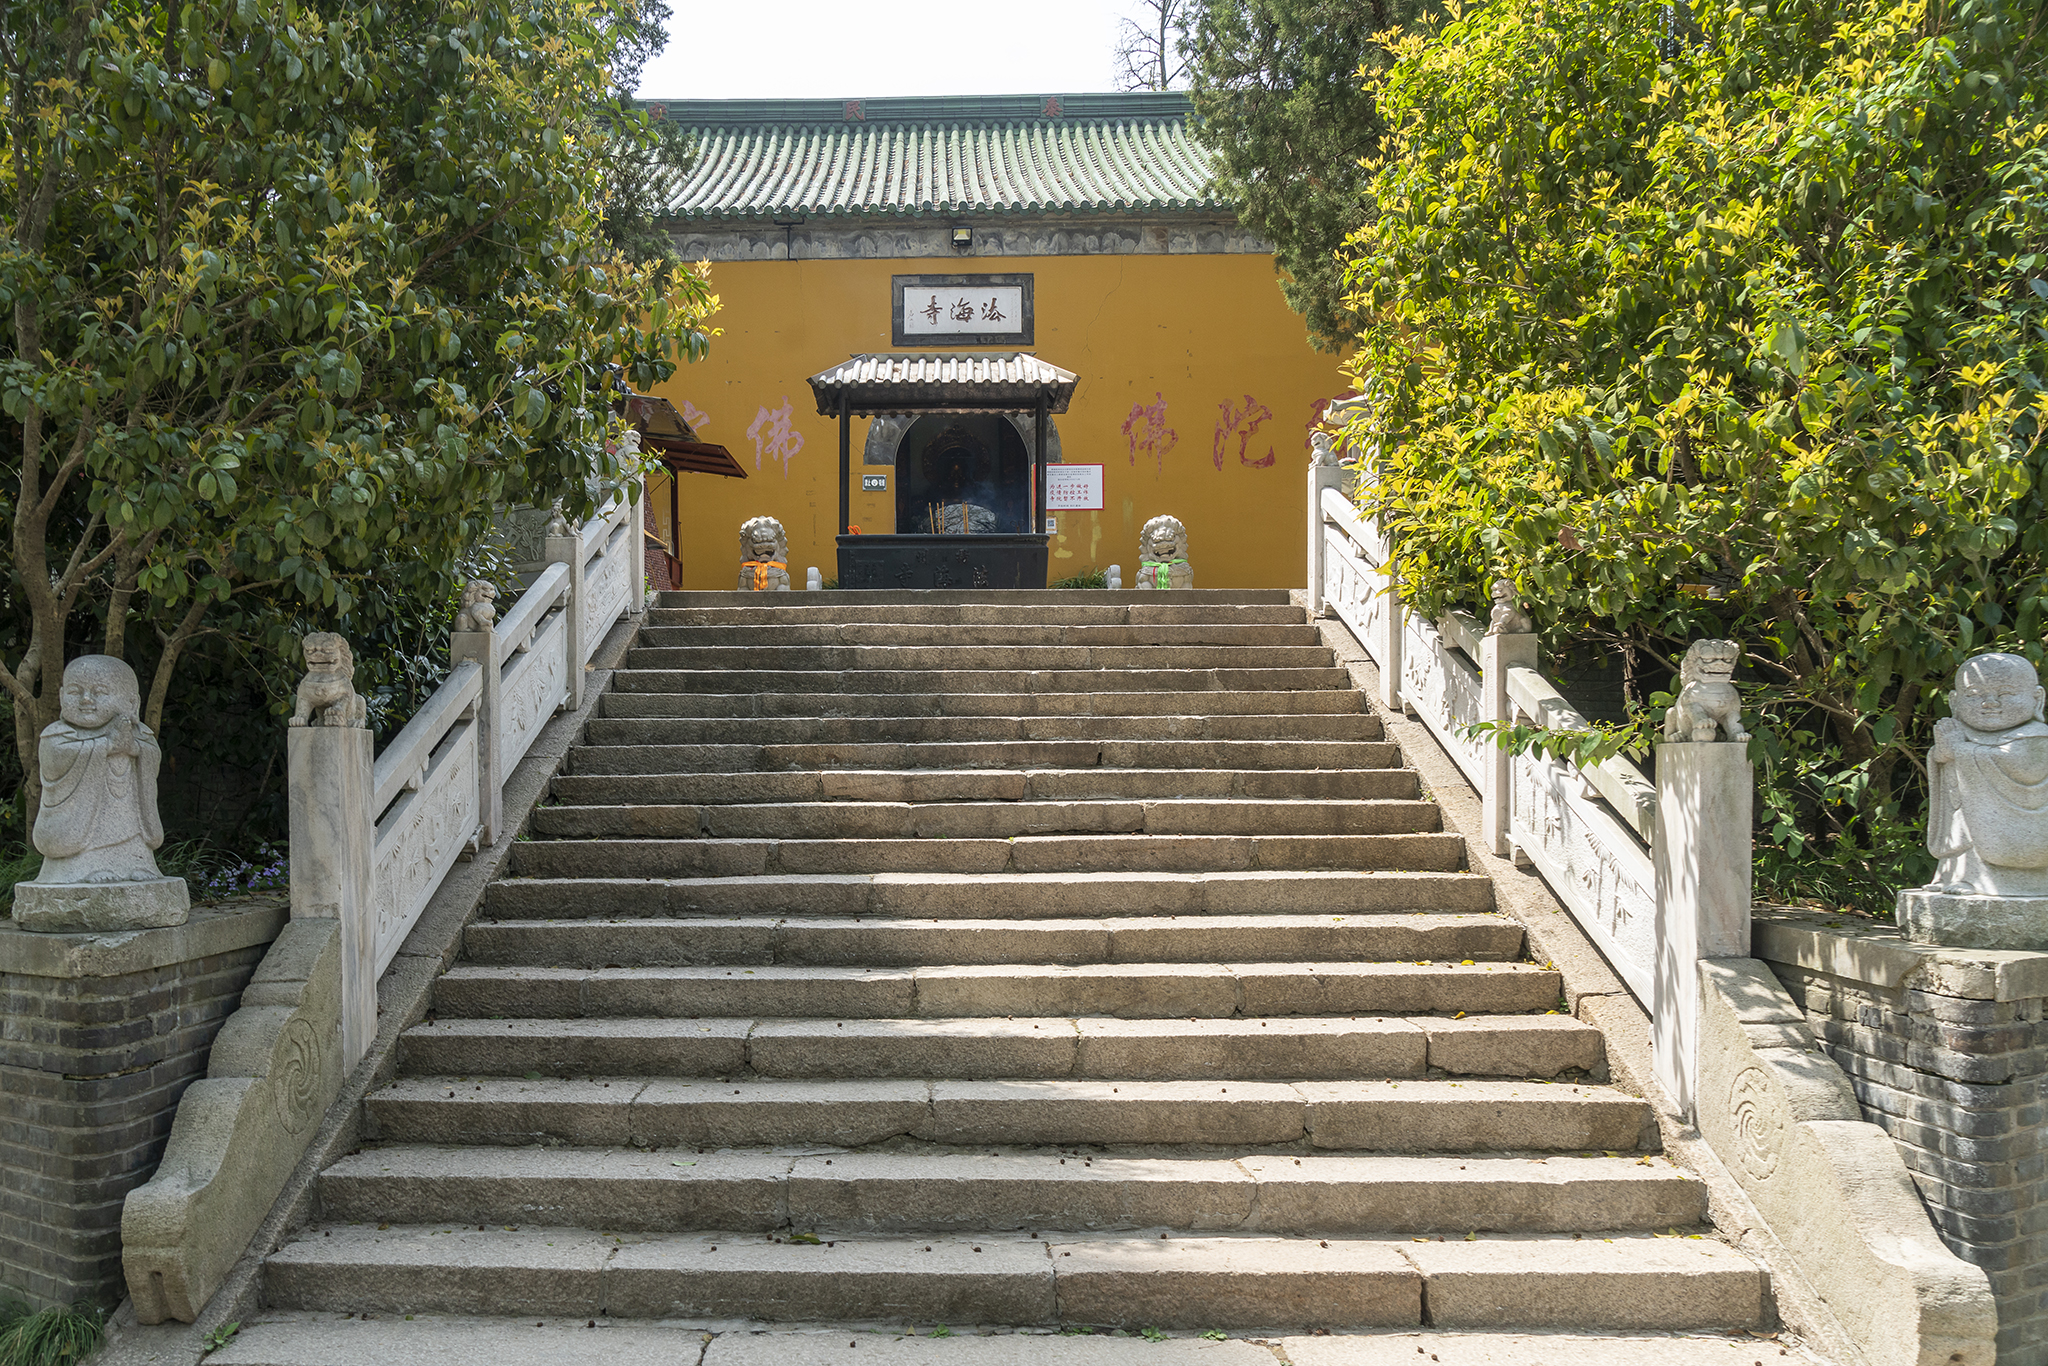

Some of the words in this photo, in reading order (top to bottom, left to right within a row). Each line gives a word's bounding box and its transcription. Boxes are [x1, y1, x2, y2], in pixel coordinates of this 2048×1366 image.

[845, 100, 864, 120] 民
[920, 295, 1006, 326] 法海寺
